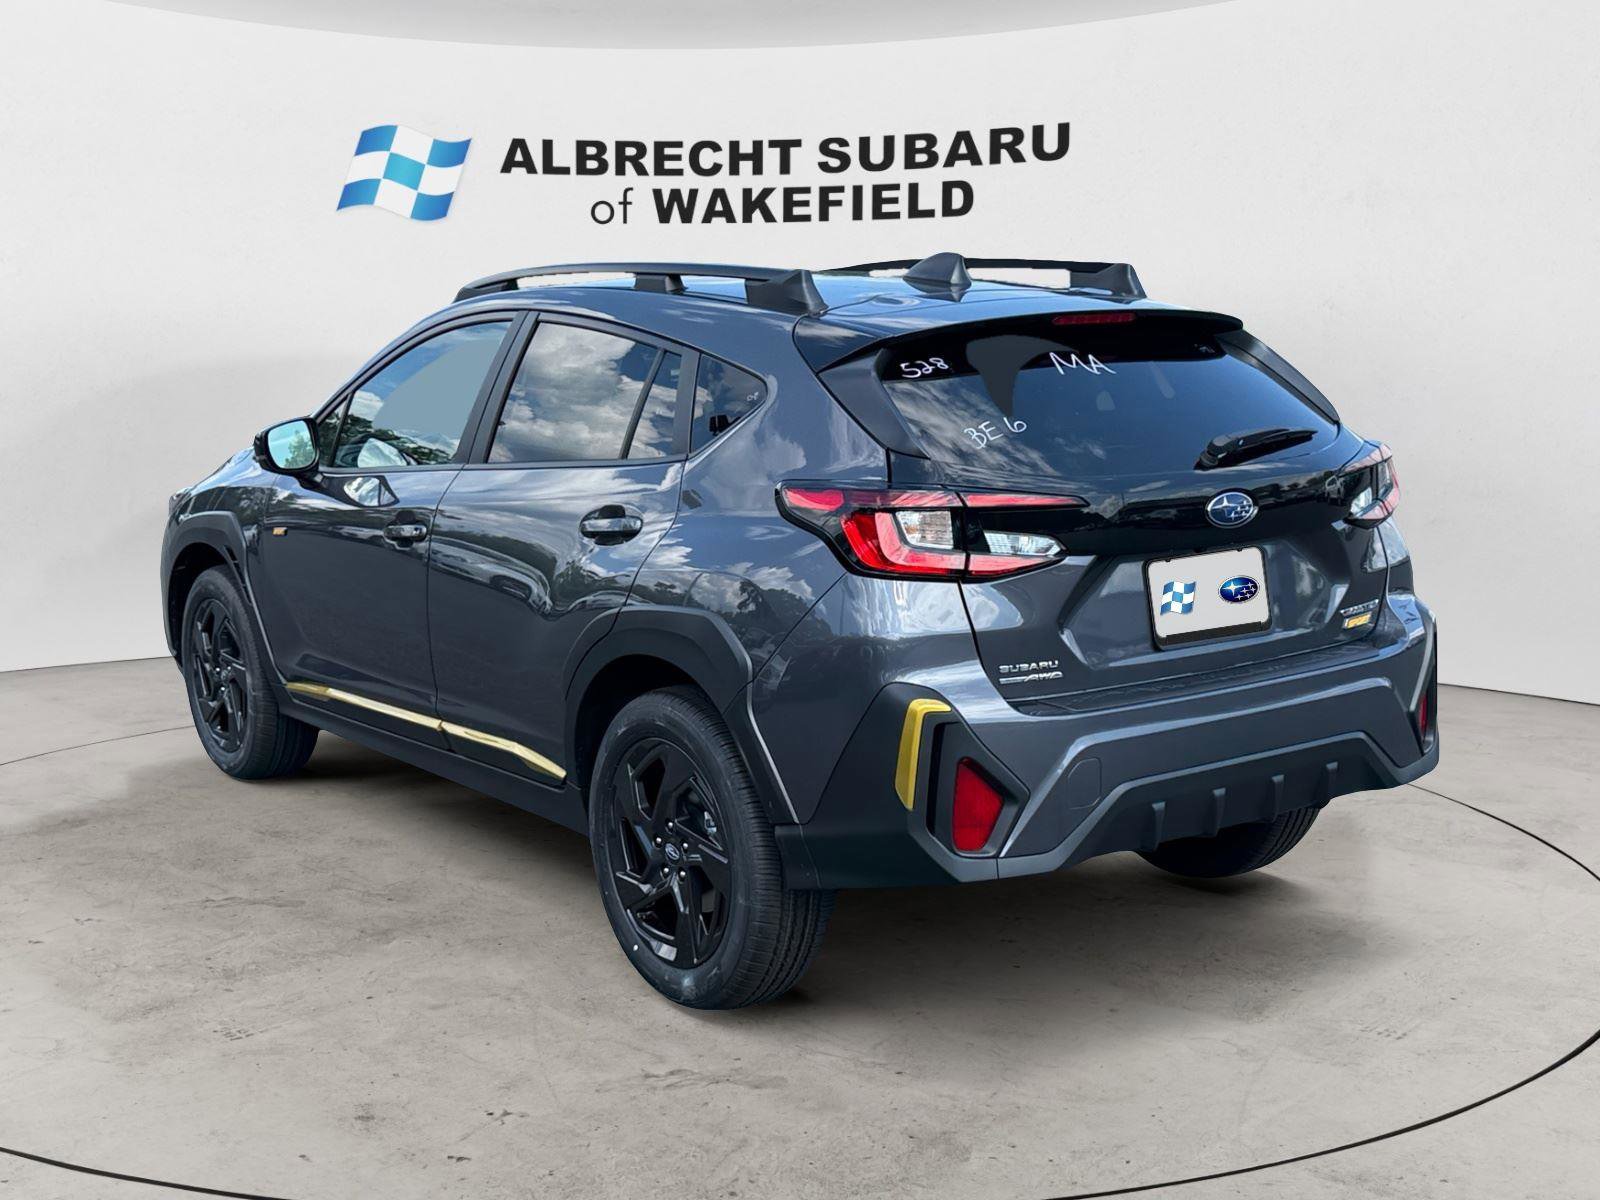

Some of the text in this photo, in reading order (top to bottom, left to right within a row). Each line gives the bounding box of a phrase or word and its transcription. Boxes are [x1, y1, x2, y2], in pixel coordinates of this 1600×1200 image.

[500, 121, 1071, 177] ALBRECHT SUBARU
[590, 180, 975, 225] of WAKEFIELD
[900, 357, 950, 380] 528
[1048, 351, 1118, 376] MA
[998, 660, 1059, 673] SUBARU
